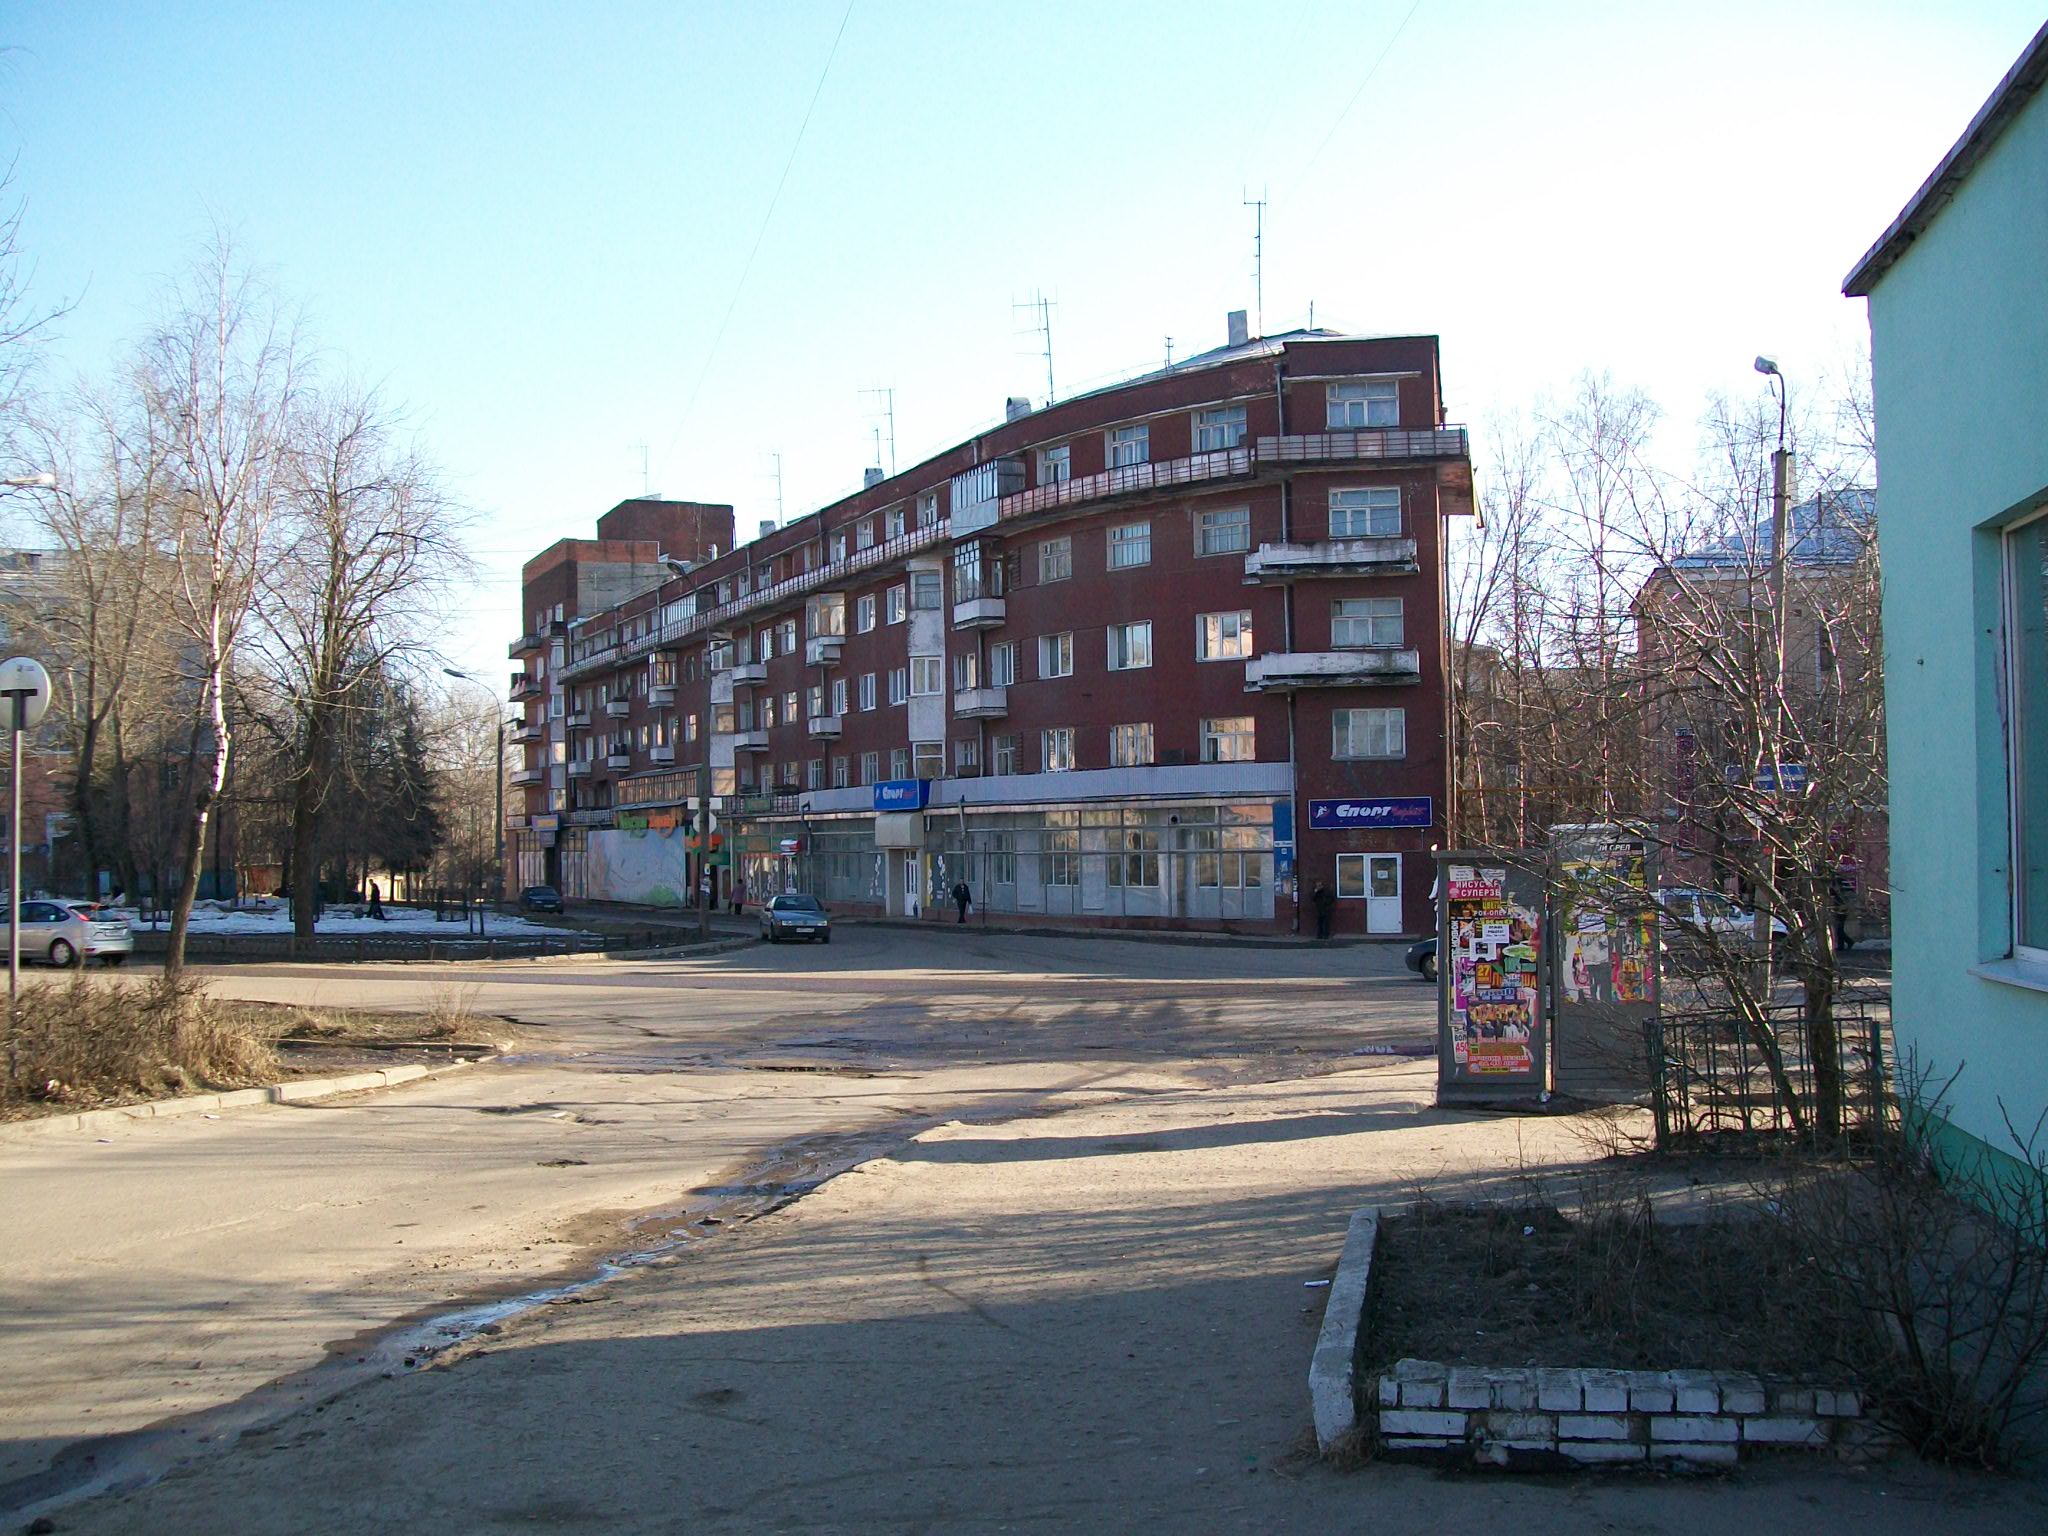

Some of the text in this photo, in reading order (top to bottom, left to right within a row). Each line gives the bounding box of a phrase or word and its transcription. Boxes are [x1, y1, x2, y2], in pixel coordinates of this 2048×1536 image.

[882, 786, 904, 800] Спорт
[1336, 804, 1391, 817] Спорт
[1477, 964, 1491, 977] 27
